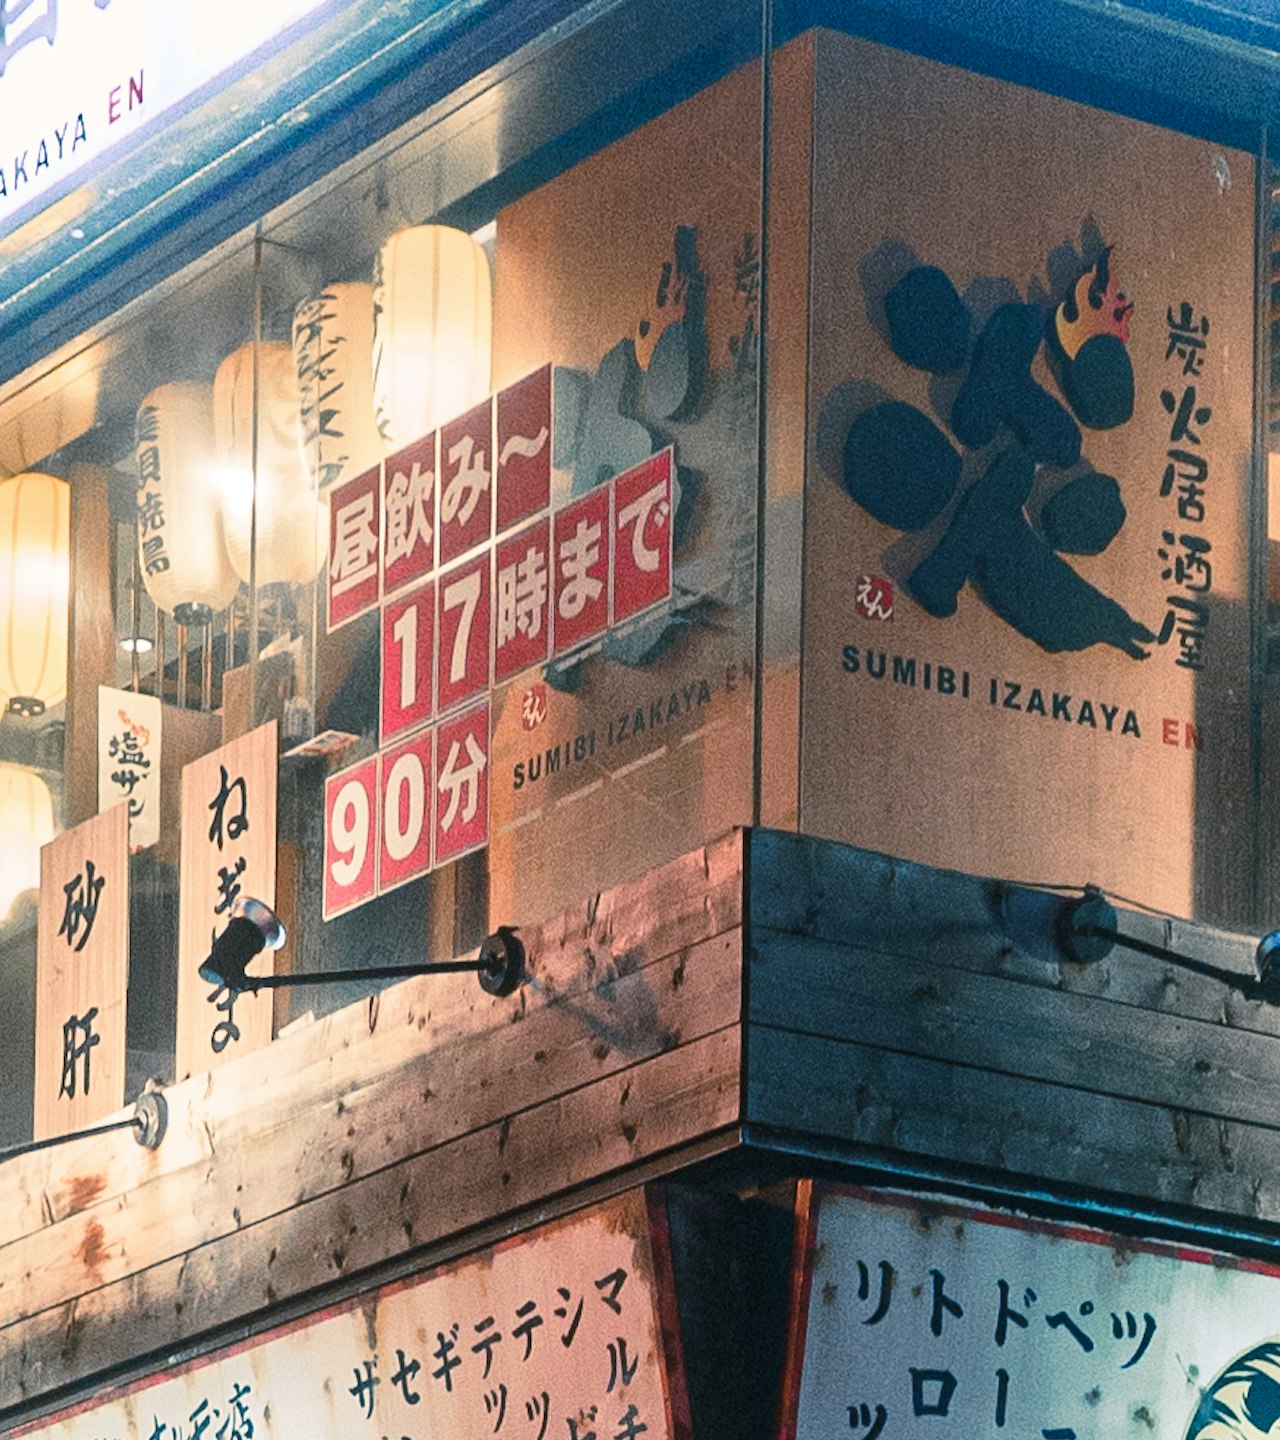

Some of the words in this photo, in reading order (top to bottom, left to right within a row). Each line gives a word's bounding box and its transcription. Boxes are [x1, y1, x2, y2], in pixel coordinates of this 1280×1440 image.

[108, 69, 146, 124] EN
[1159, 301, 1214, 672] 炭火居酒屋
[393, 478, 671, 710] 17時まで
[514, 731, 597, 789] SUMIBI
[607, 683, 712, 745] IZAKAYA
[842, 643, 971, 700] SUMIBI
[989, 679, 1141, 739] IZAKAYA
[330, 731, 489, 887] 90分
[59, 861, 105, 1100] 砂肝
